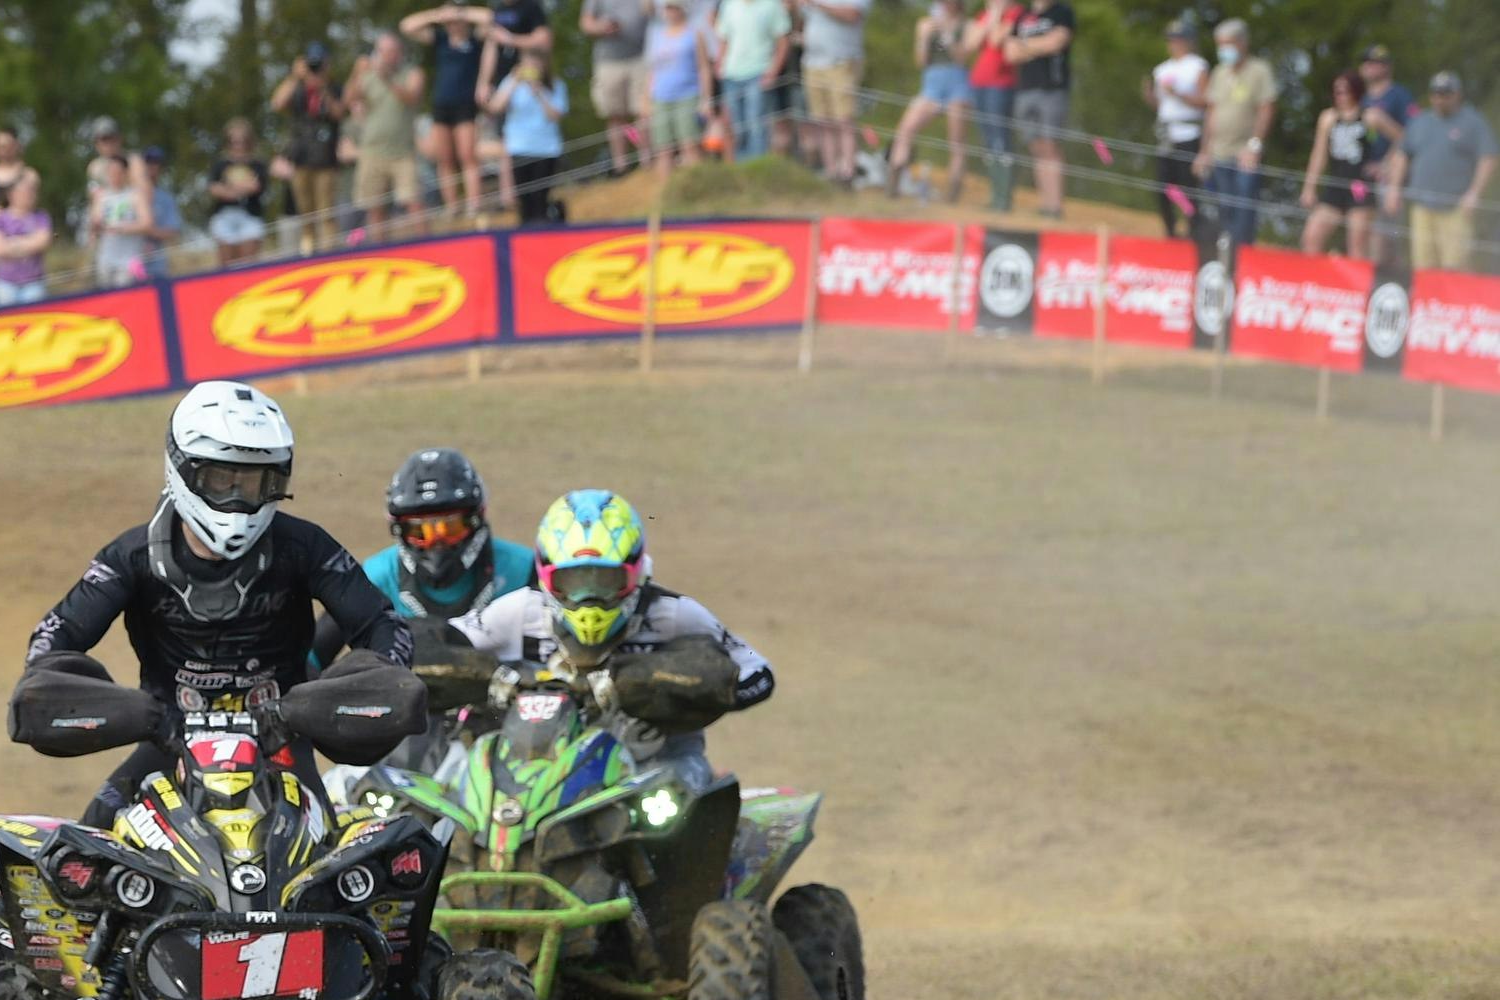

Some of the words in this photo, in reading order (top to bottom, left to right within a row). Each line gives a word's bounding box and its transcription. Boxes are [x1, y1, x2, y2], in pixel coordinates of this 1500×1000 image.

[214, 262, 462, 347] FMF
[547, 238, 791, 305] FMF
[211, 739, 240, 763] 1
[238, 931, 288, 1000] 1
